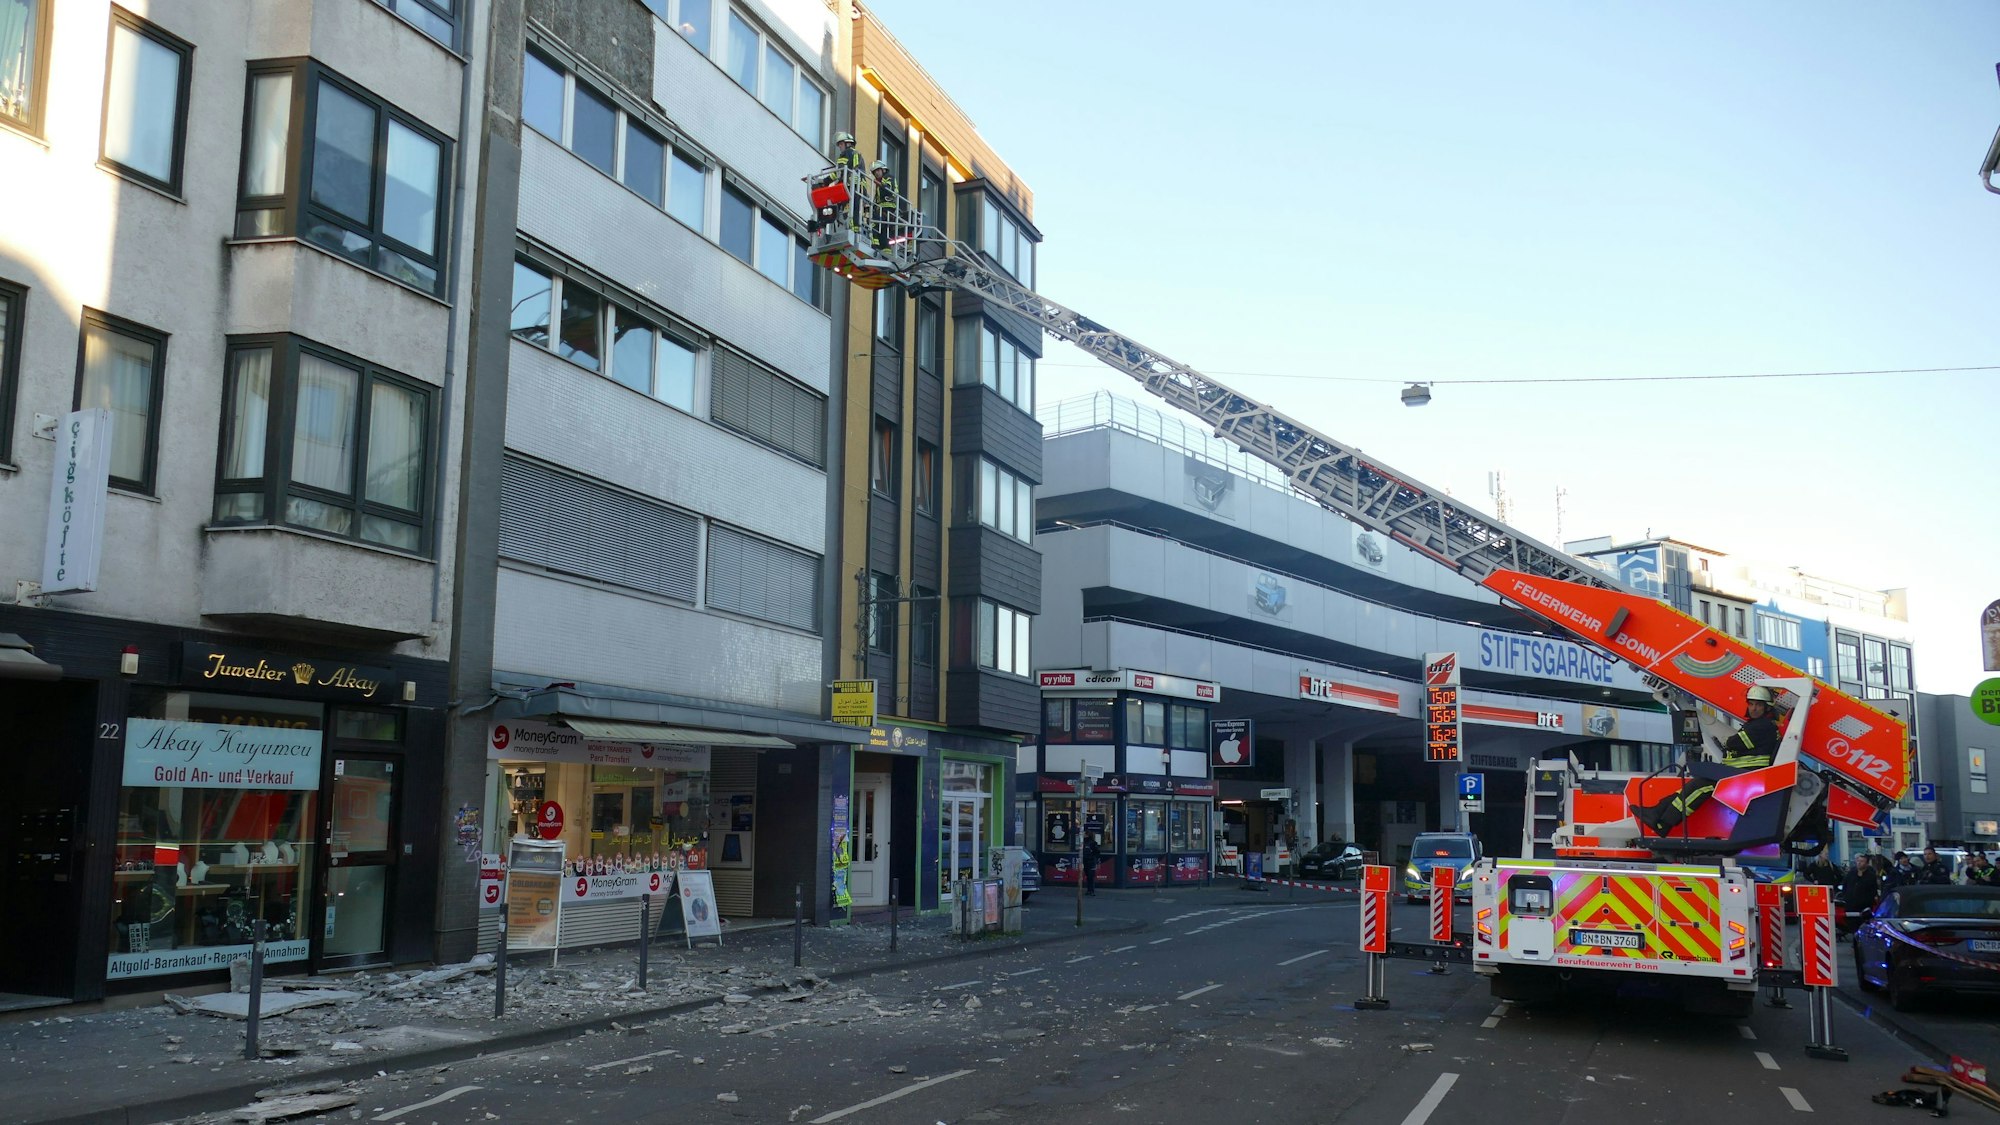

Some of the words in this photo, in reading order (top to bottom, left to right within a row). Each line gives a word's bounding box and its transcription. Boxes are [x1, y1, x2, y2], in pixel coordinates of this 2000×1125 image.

[1513, 580, 1602, 633] FEUERWEHR
[1615, 632, 1660, 662] BONN
[1481, 632, 1612, 683] STIFTSGARAGE
[203, 653, 287, 682] Juwelier
[317, 667, 381, 698] Akay
[1430, 662, 1452, 673] bft
[1085, 674, 1121, 683] edicom
[1310, 678, 1332, 698] bft
[1537, 711, 1559, 728] bft
[99, 723, 119, 740] 22
[514, 729, 578, 747] MoneyGram
[136, 725, 205, 762] Akay
[606, 745, 633, 753] TRANSFER
[590, 754, 604, 762] Para
[1471, 754, 1517, 769] STIFTSGARAGE
[1846, 749, 1893, 779] 112
[154, 766, 186, 782] Gold
[191, 768, 213, 783] An-
[219, 769, 241, 784] und
[246, 769, 294, 785] Verkauf
[1466, 779, 1476, 793] P
[1917, 785, 1930, 799] P
[591, 877, 638, 889] MoneyGram
[1582, 934, 1594, 945] BN
[1601, 935, 1612, 946] BN
[1614, 935, 1637, 947] 3760
[110, 953, 208, 976] Altgold-Barankauf
[263, 945, 307, 960] Annahme
[1557, 957, 1632, 970] Berufsfeuerwehr
[1635, 962, 1658, 971] Bonn
